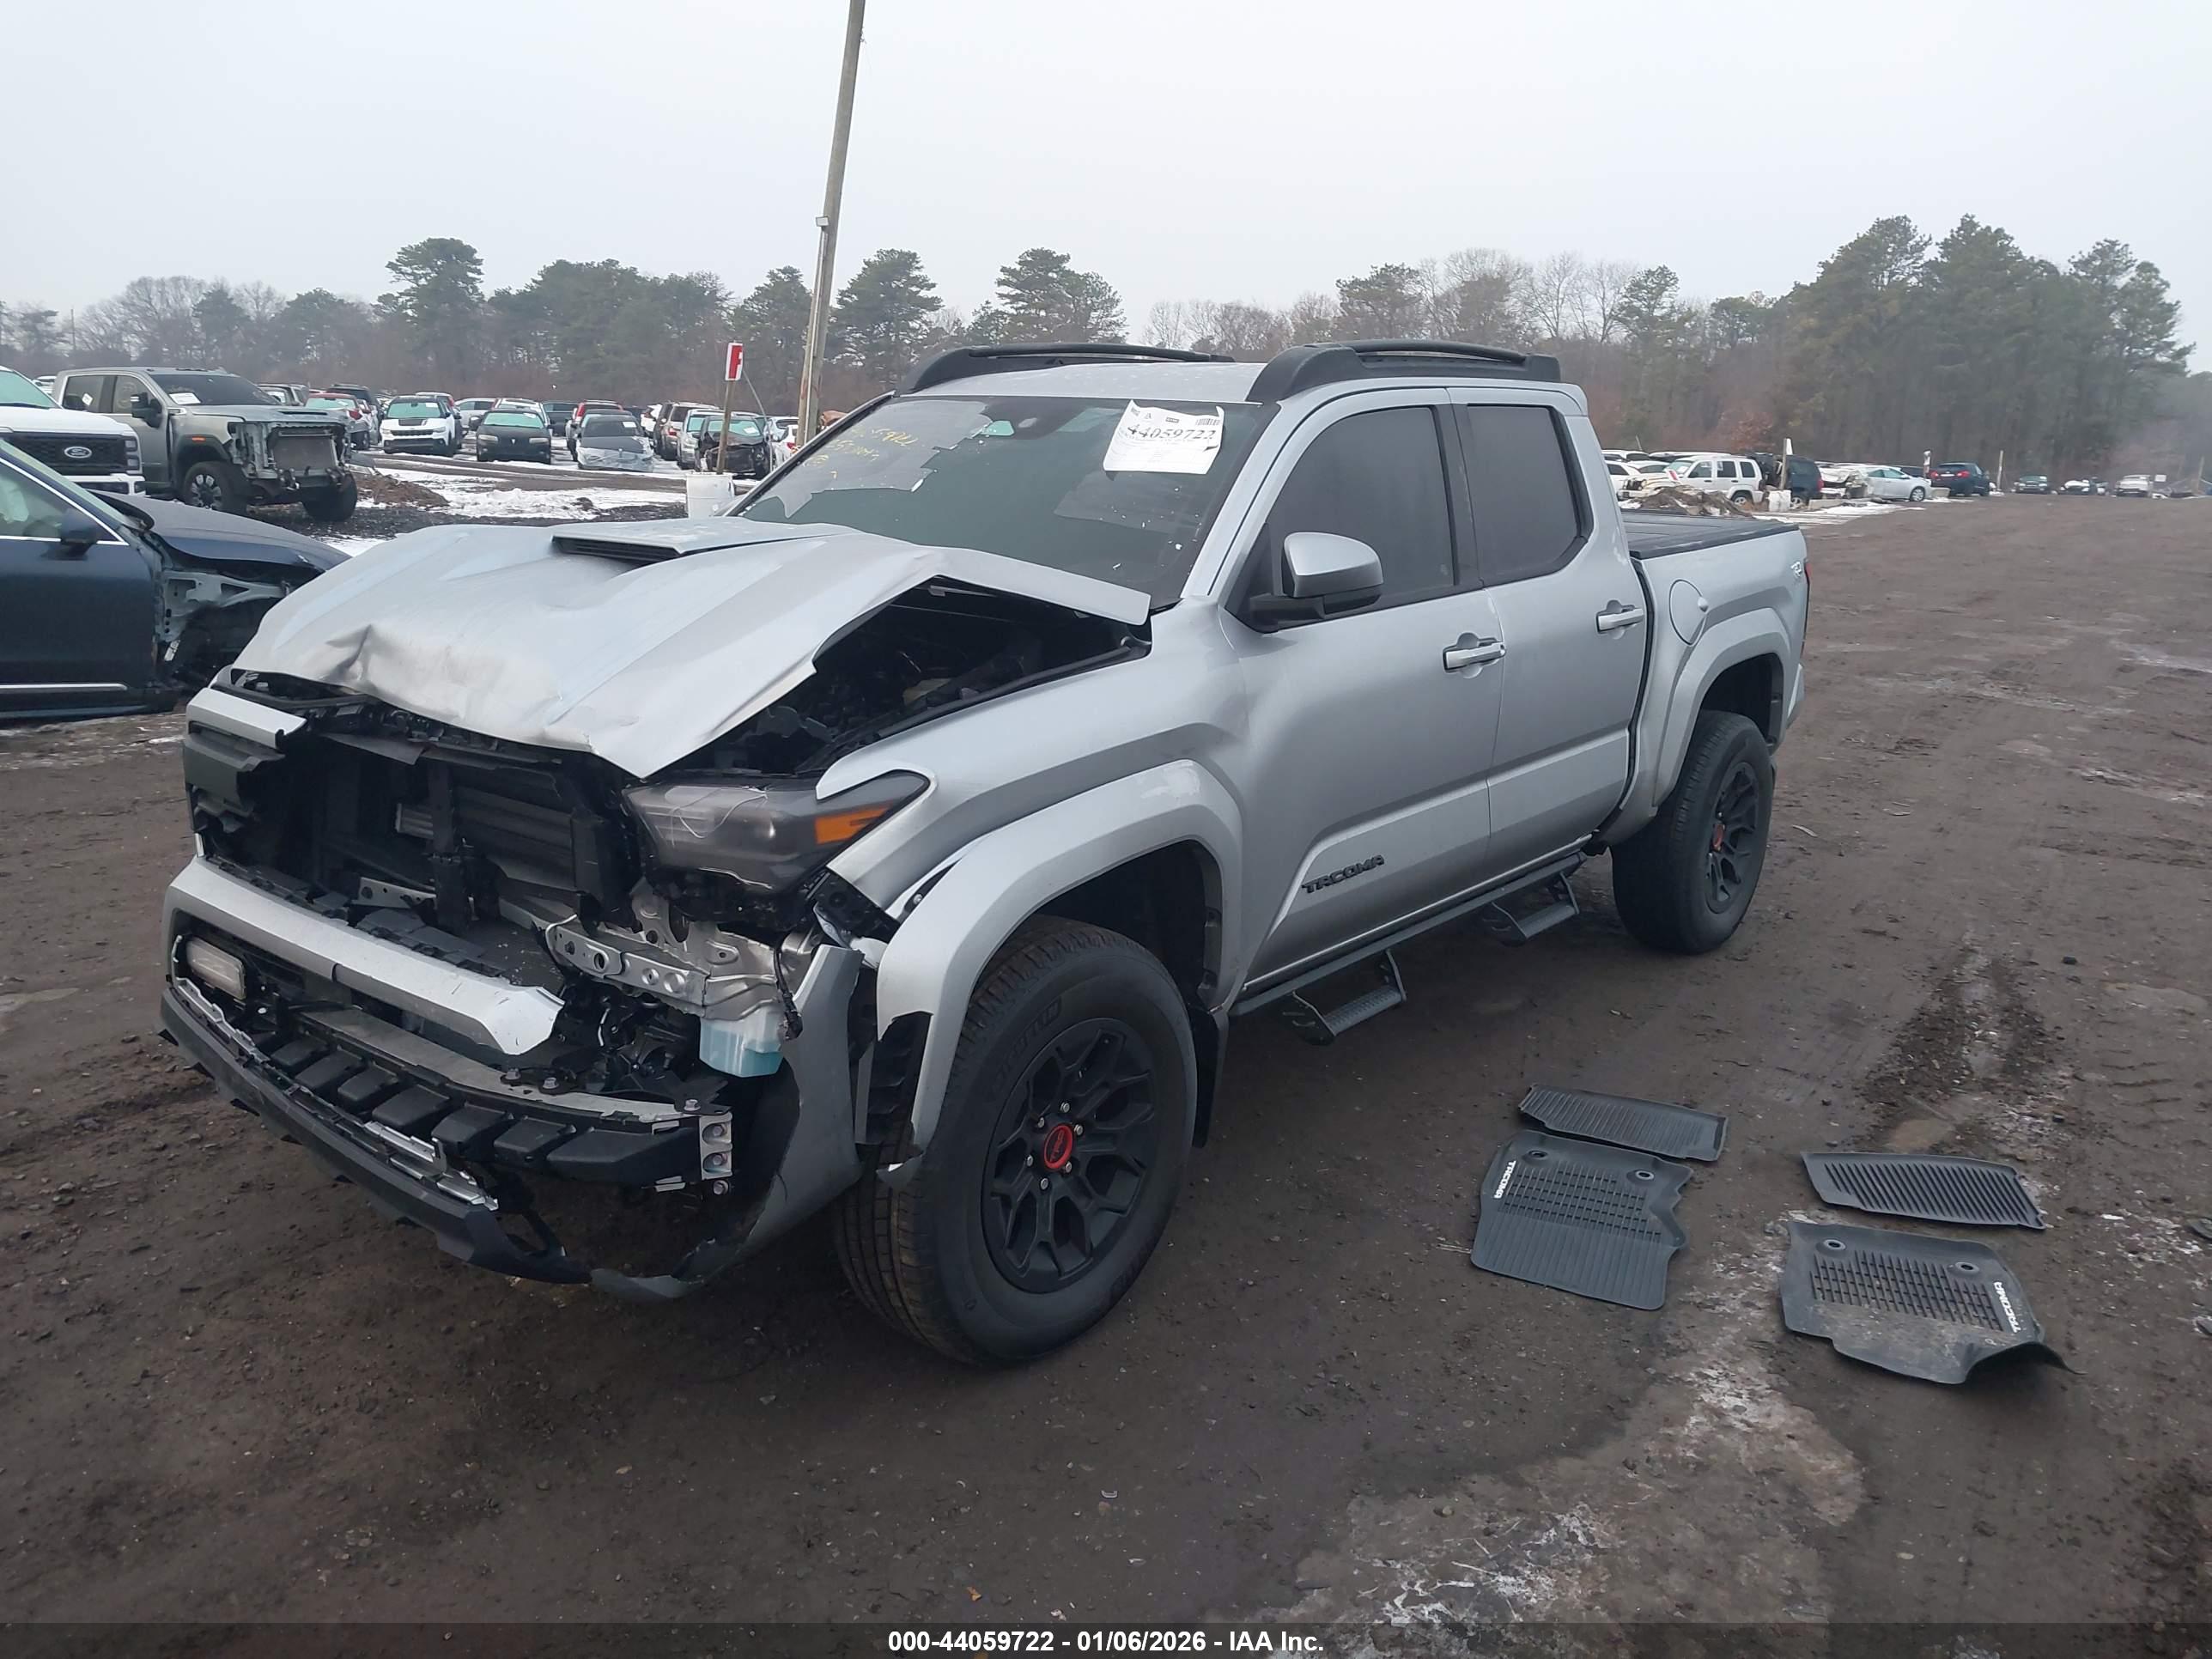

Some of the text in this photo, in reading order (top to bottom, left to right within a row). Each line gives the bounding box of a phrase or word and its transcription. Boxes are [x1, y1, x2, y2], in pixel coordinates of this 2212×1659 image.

[1127, 423, 1217, 441] 44059722
[1301, 854, 1385, 894] TACOMA
[1493, 1160, 1517, 1200] TACOMA
[1993, 1281, 2022, 1334] TACOMA
